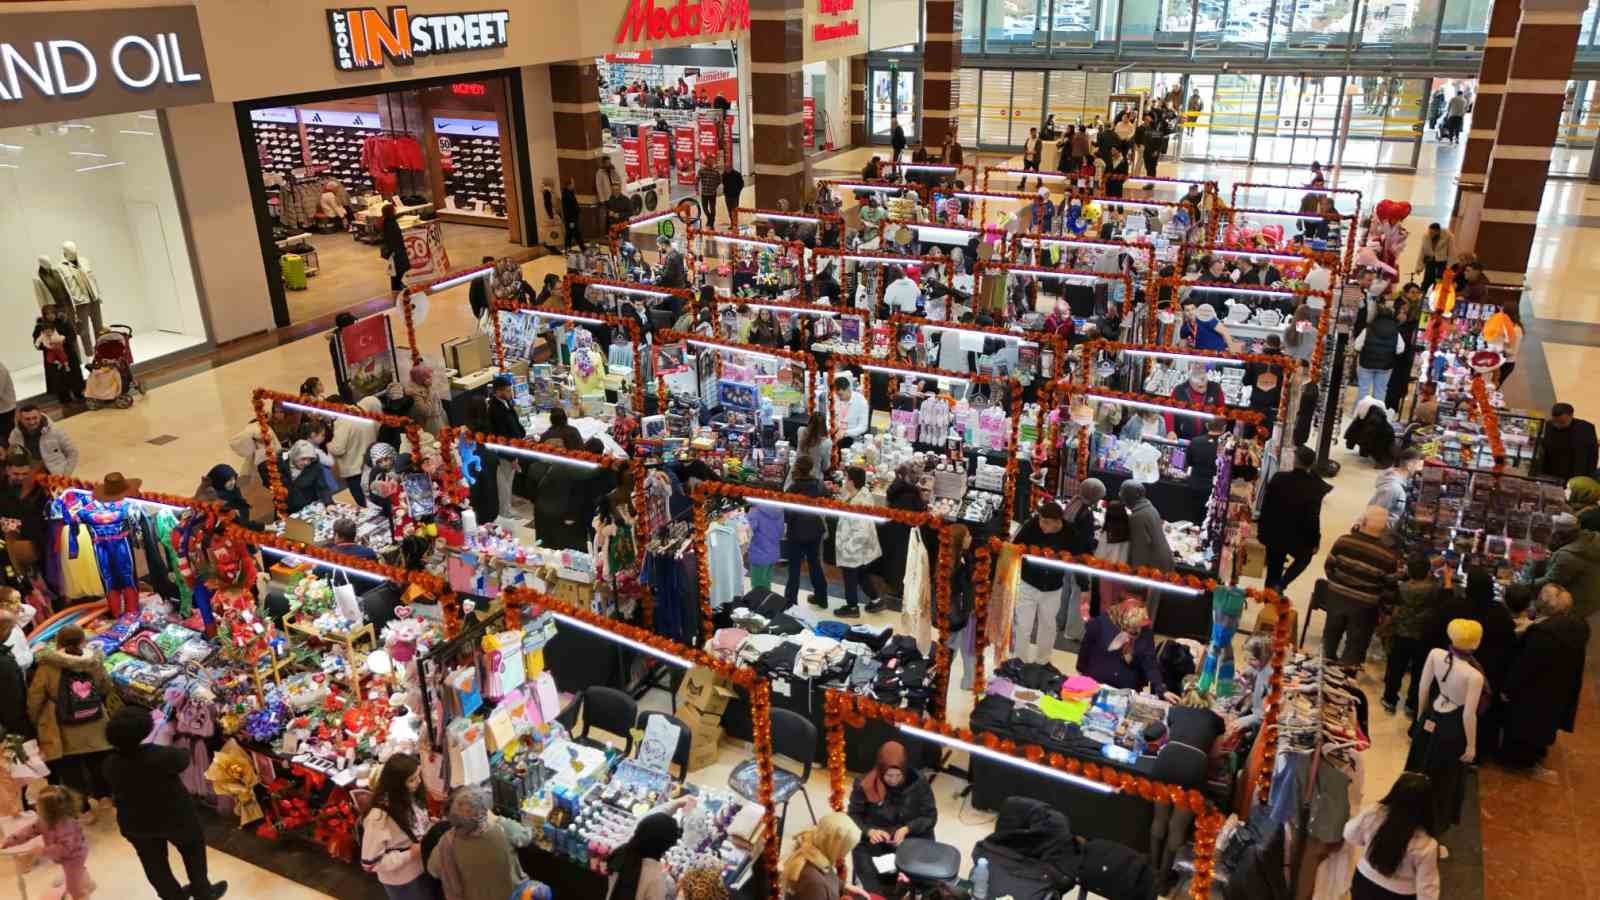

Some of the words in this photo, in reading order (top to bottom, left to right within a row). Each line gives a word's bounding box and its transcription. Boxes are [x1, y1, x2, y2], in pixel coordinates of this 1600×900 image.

[0, 39, 97, 100] ND
[112, 32, 202, 88] OIL
[333, 11, 353, 69] SPORT
